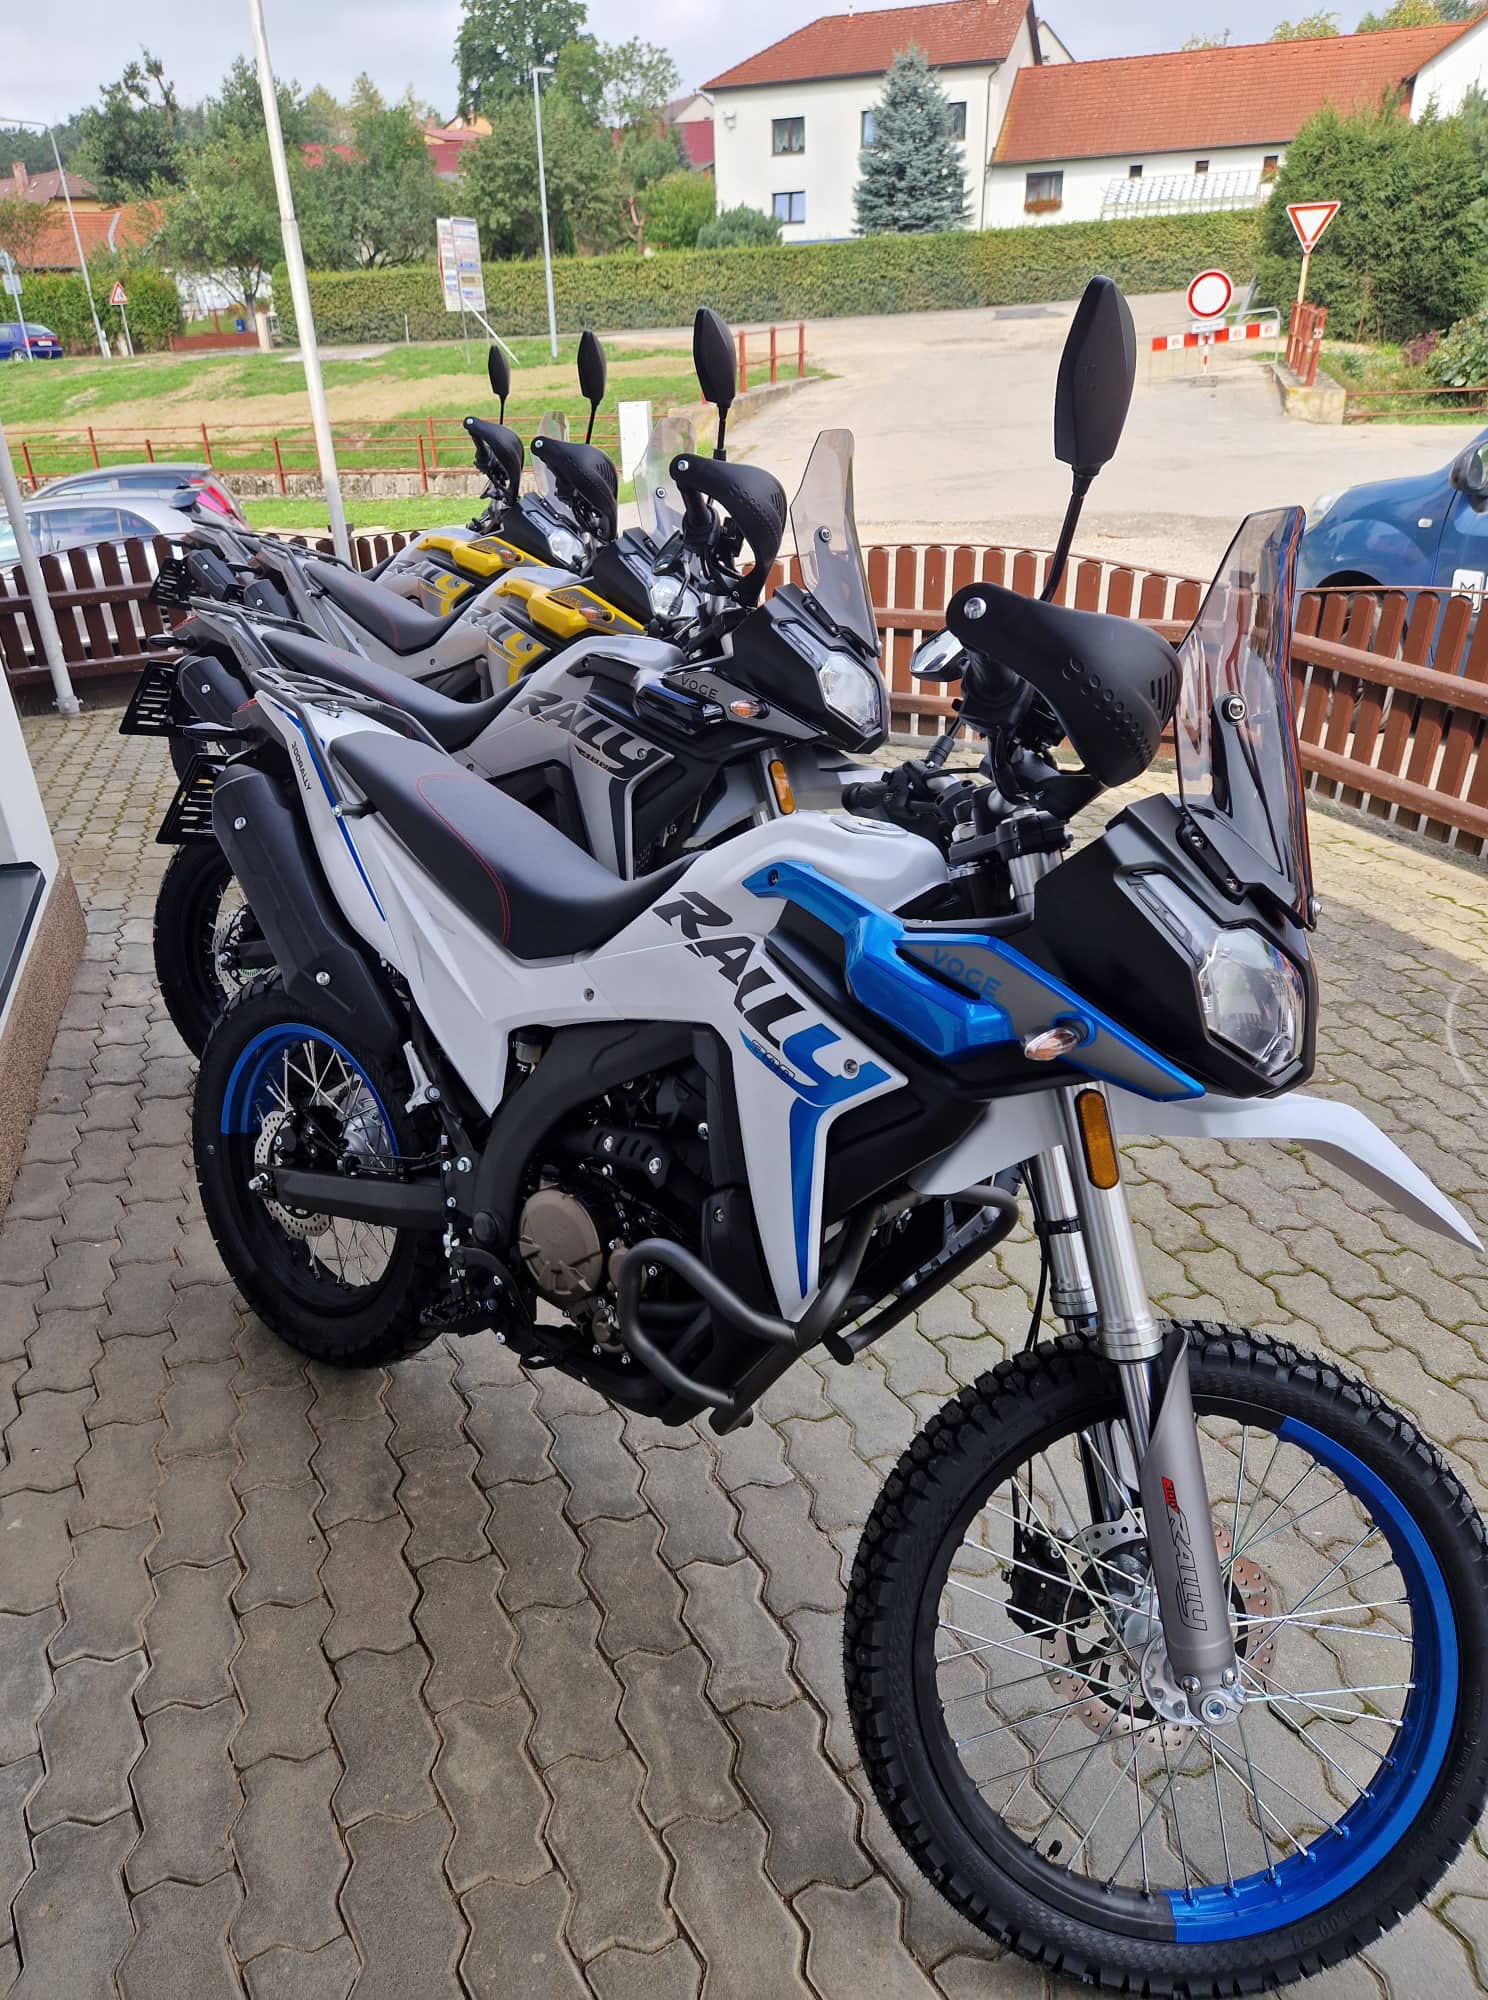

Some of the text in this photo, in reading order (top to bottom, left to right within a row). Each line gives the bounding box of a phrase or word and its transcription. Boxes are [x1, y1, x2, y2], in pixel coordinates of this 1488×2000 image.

[681, 675, 720, 700] VOGE
[508, 689, 674, 780] RALLY
[652, 891, 892, 1107] RALLY
[933, 946, 1004, 998] VOGE
[1166, 1503, 1208, 1631] RALLY
